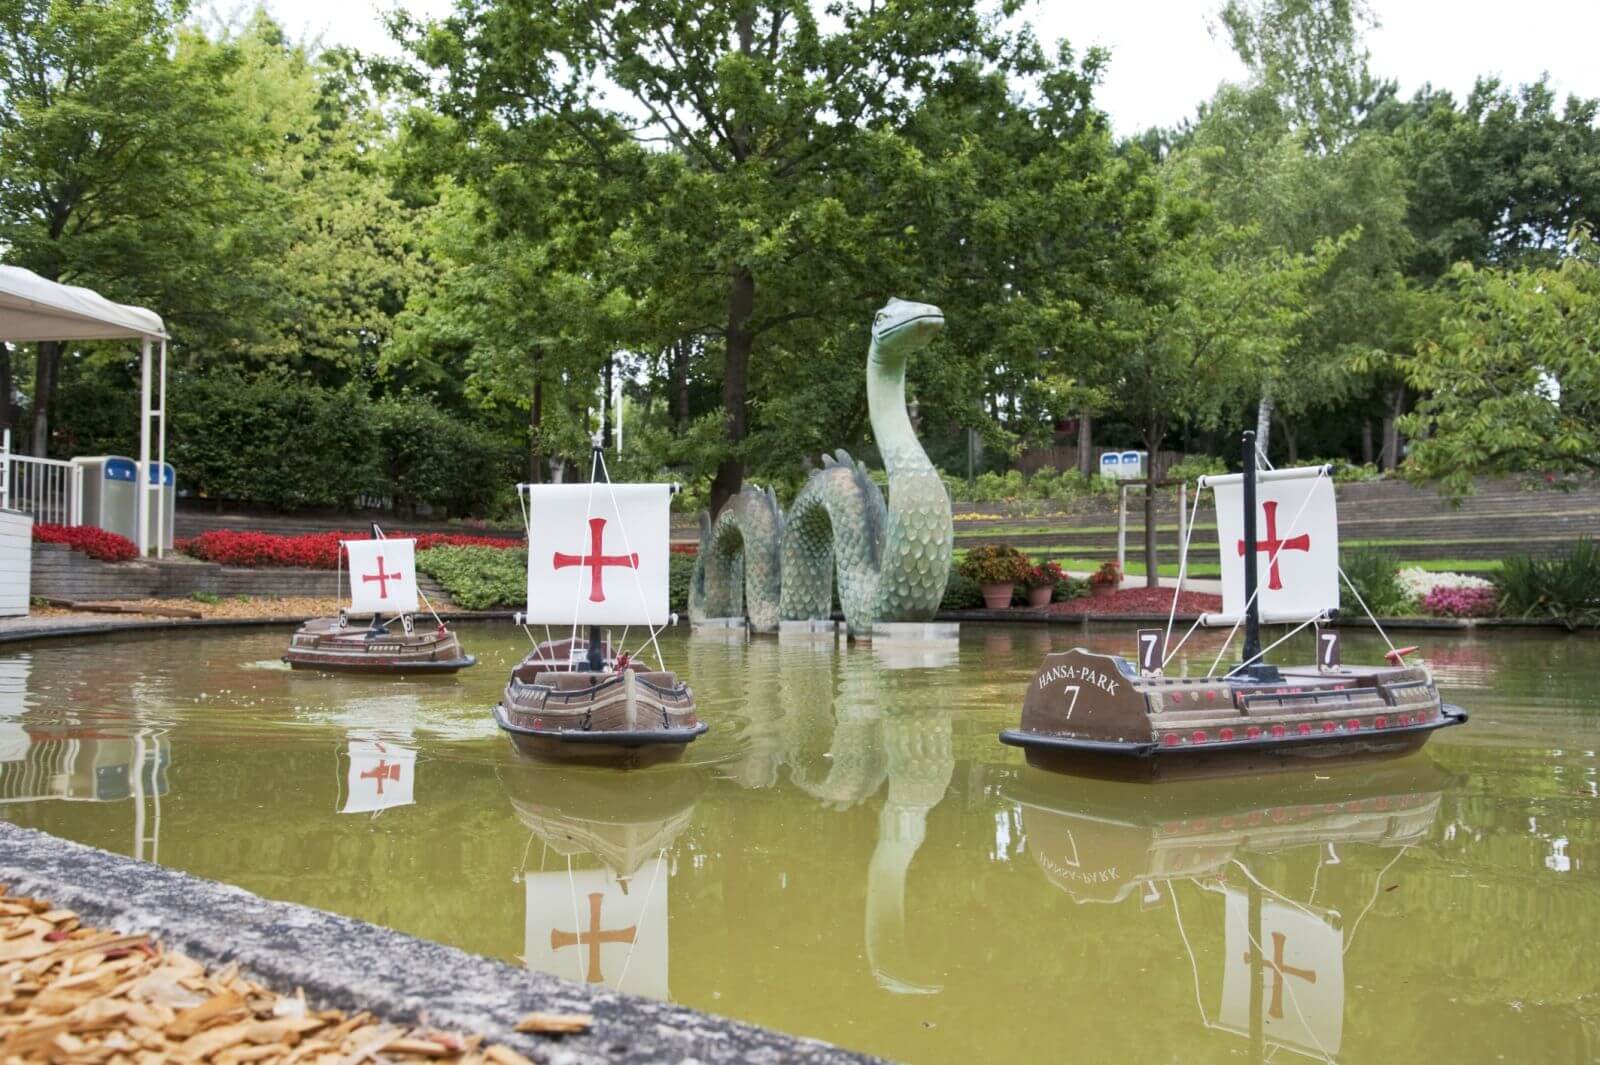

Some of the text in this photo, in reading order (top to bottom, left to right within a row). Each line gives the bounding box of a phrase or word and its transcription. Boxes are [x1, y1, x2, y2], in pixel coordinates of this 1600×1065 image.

[404, 615, 412, 631] 6
[1141, 634, 1158, 668] 7
[1321, 633, 1337, 664] 7
[1039, 665, 1120, 696] HANSA-PARK
[1064, 685, 1080, 720] 7
